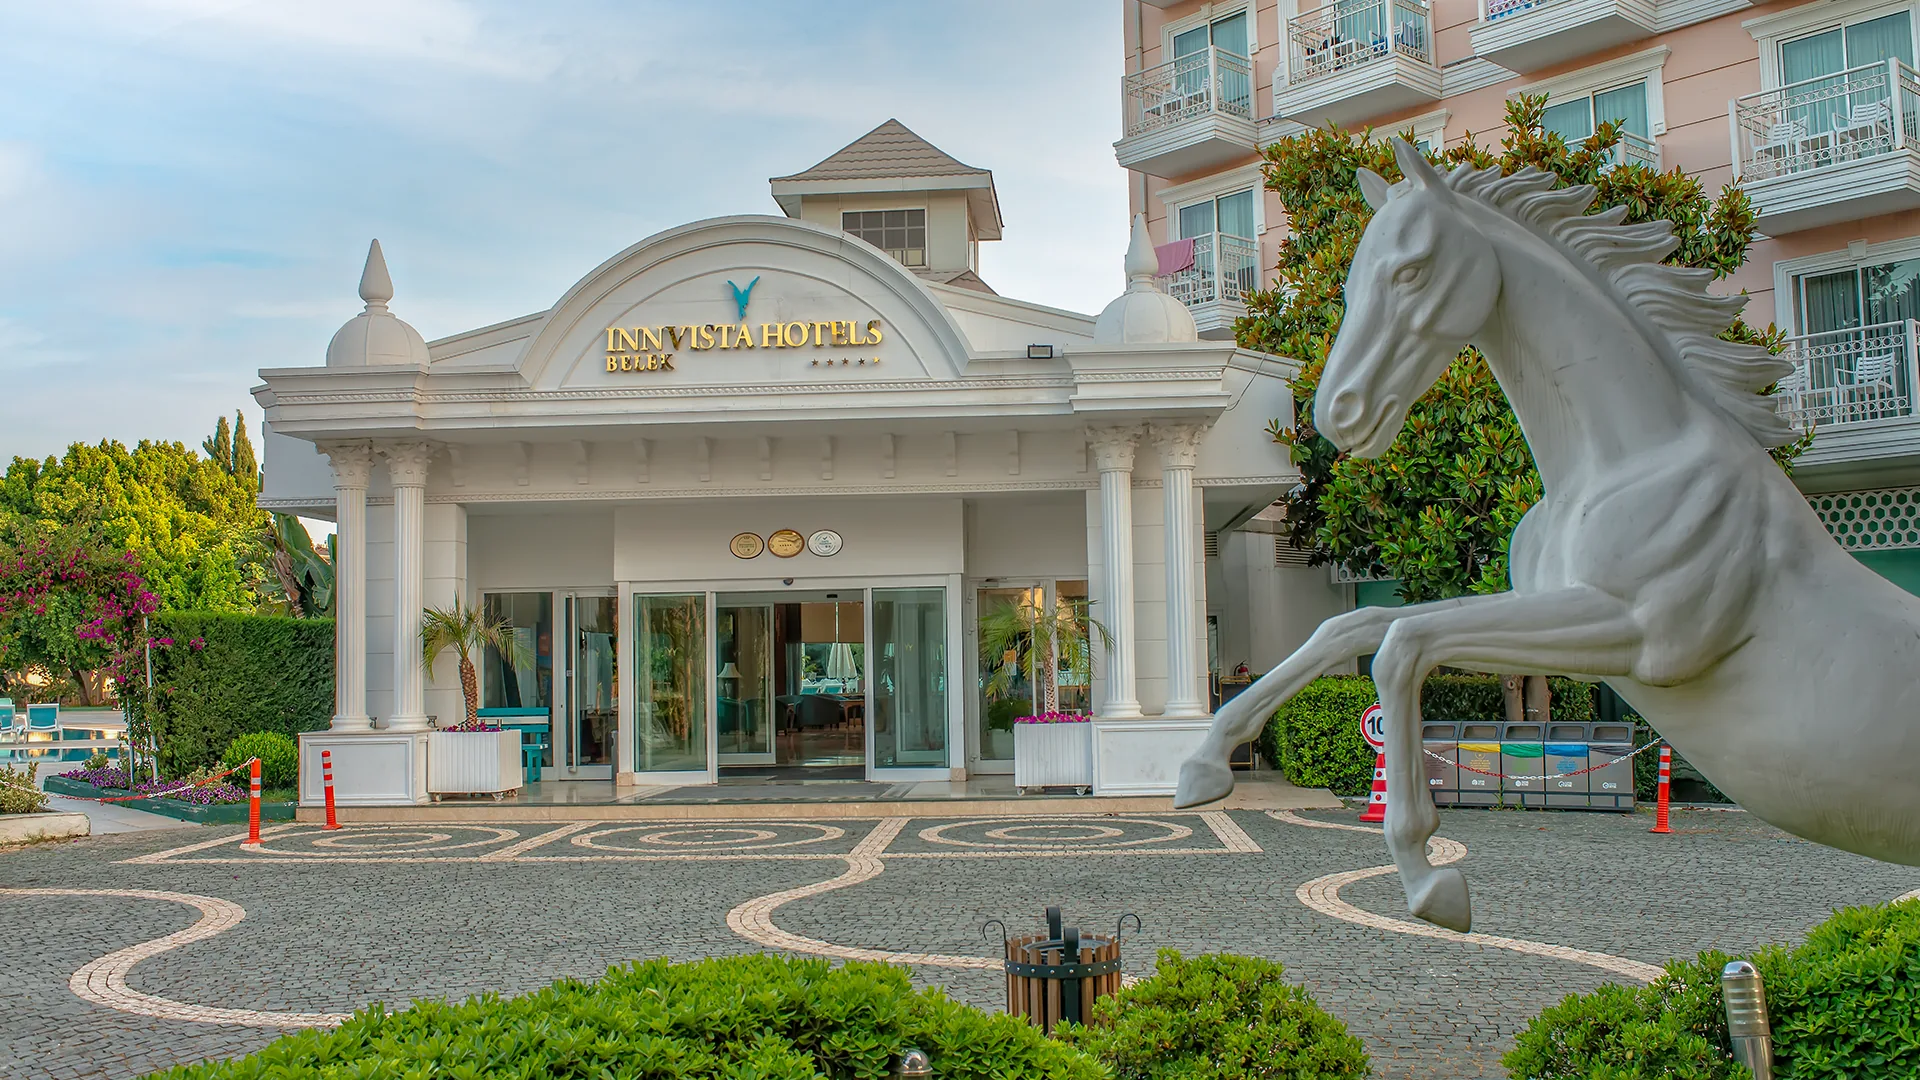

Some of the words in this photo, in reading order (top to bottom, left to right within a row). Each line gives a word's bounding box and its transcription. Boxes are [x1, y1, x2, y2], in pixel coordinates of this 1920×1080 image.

[605, 323, 756, 352] INNVISTA
[760, 319, 883, 348] HOTELS
[605, 353, 675, 372] BELEK
